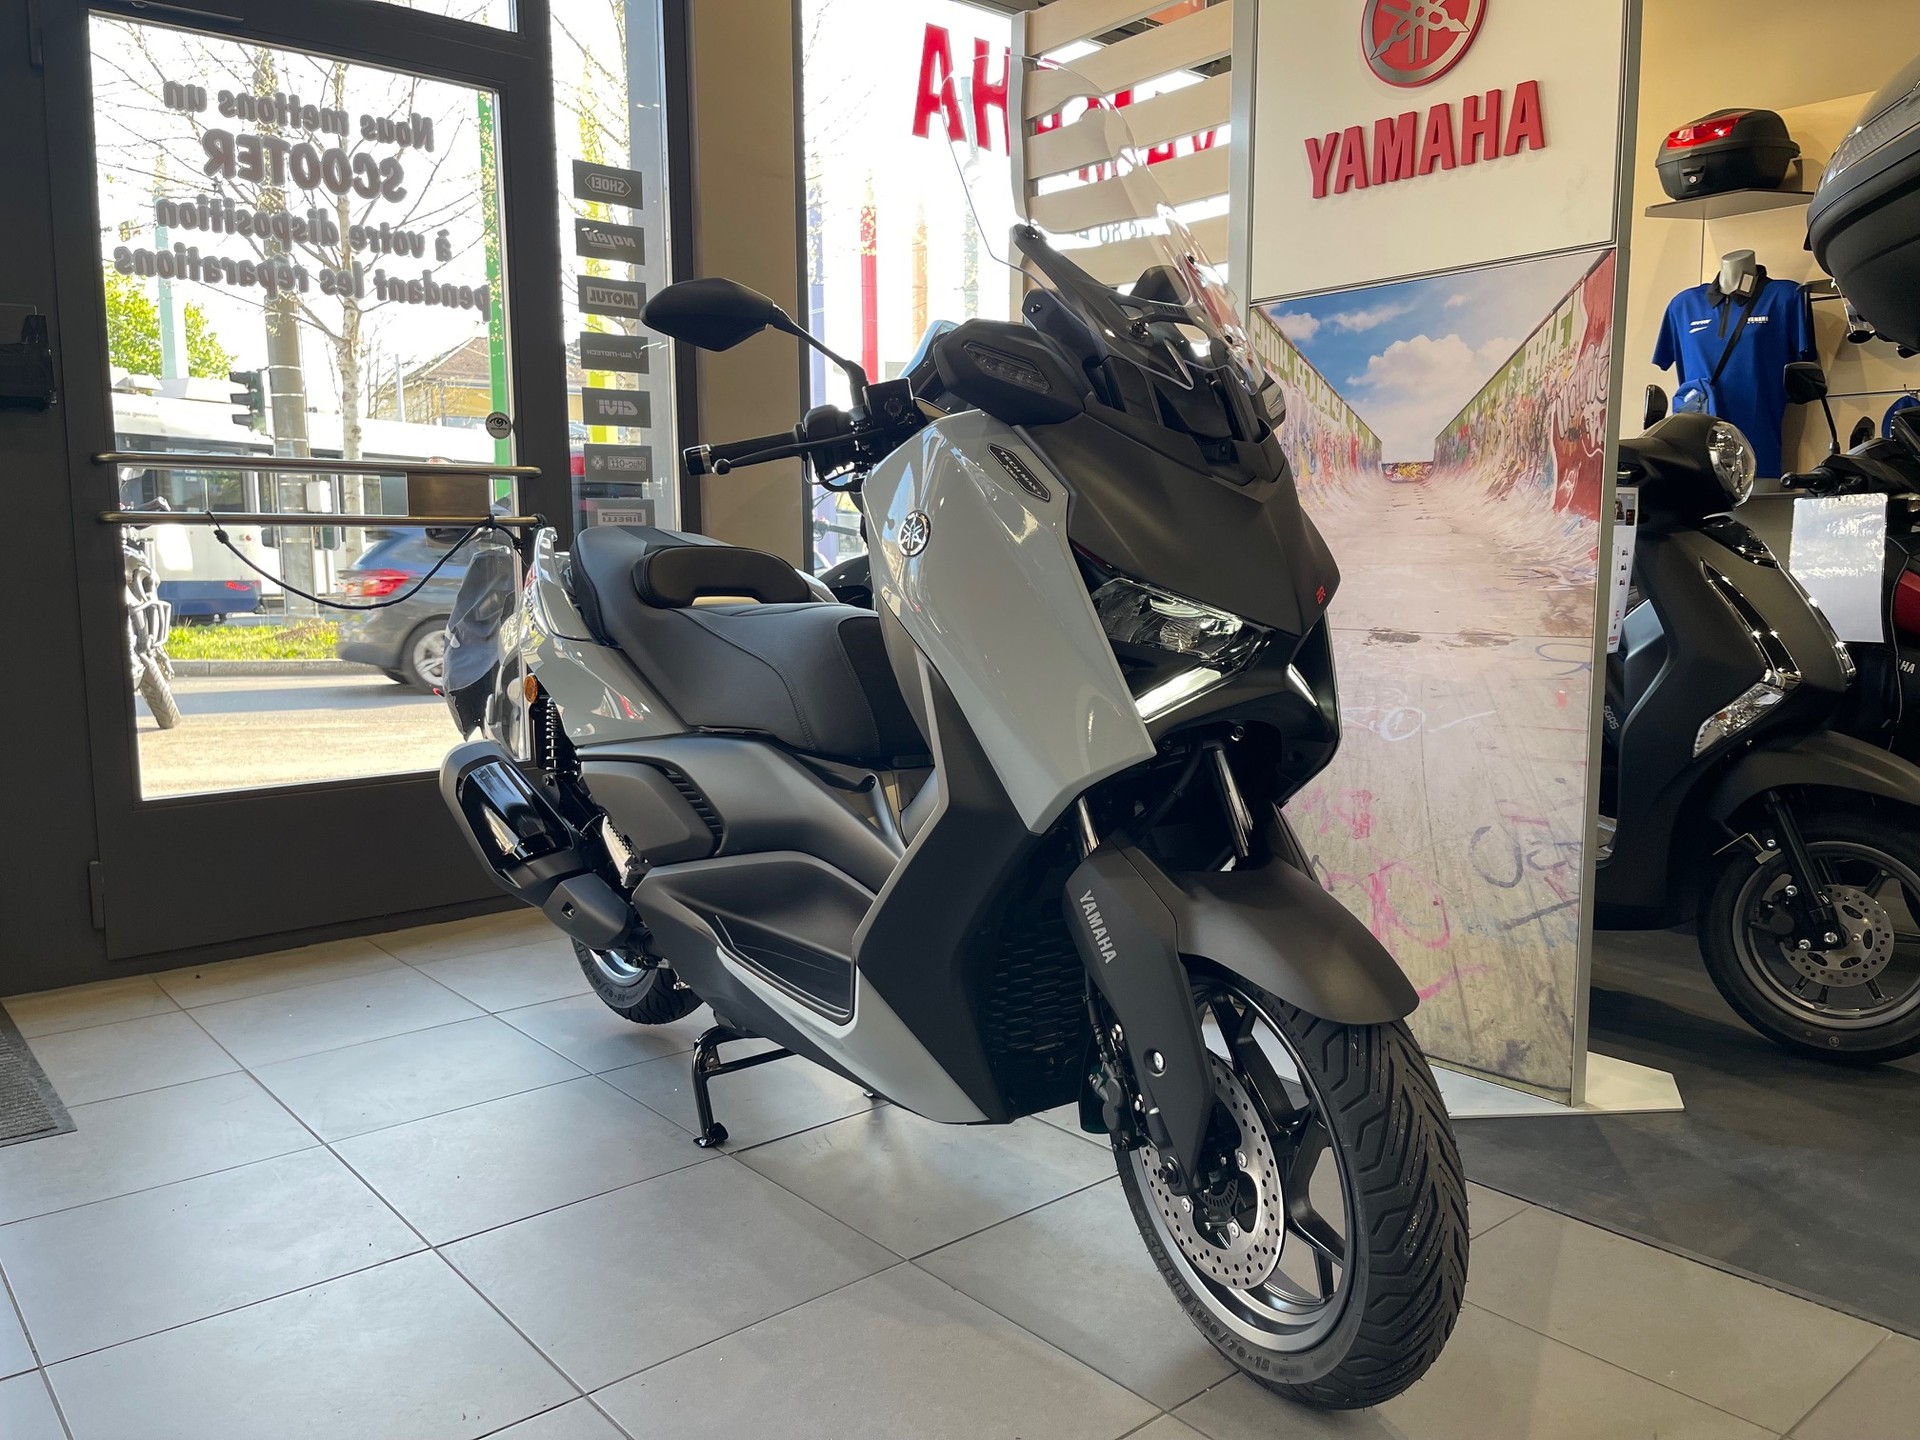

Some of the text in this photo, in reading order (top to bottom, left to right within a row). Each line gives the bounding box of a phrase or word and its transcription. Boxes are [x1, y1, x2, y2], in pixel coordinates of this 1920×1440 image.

[1304, 80, 1546, 199] YAMAHA
[1080, 889, 1118, 964] YAMAHA
[1135, 1206, 1189, 1299] MICHELIN
